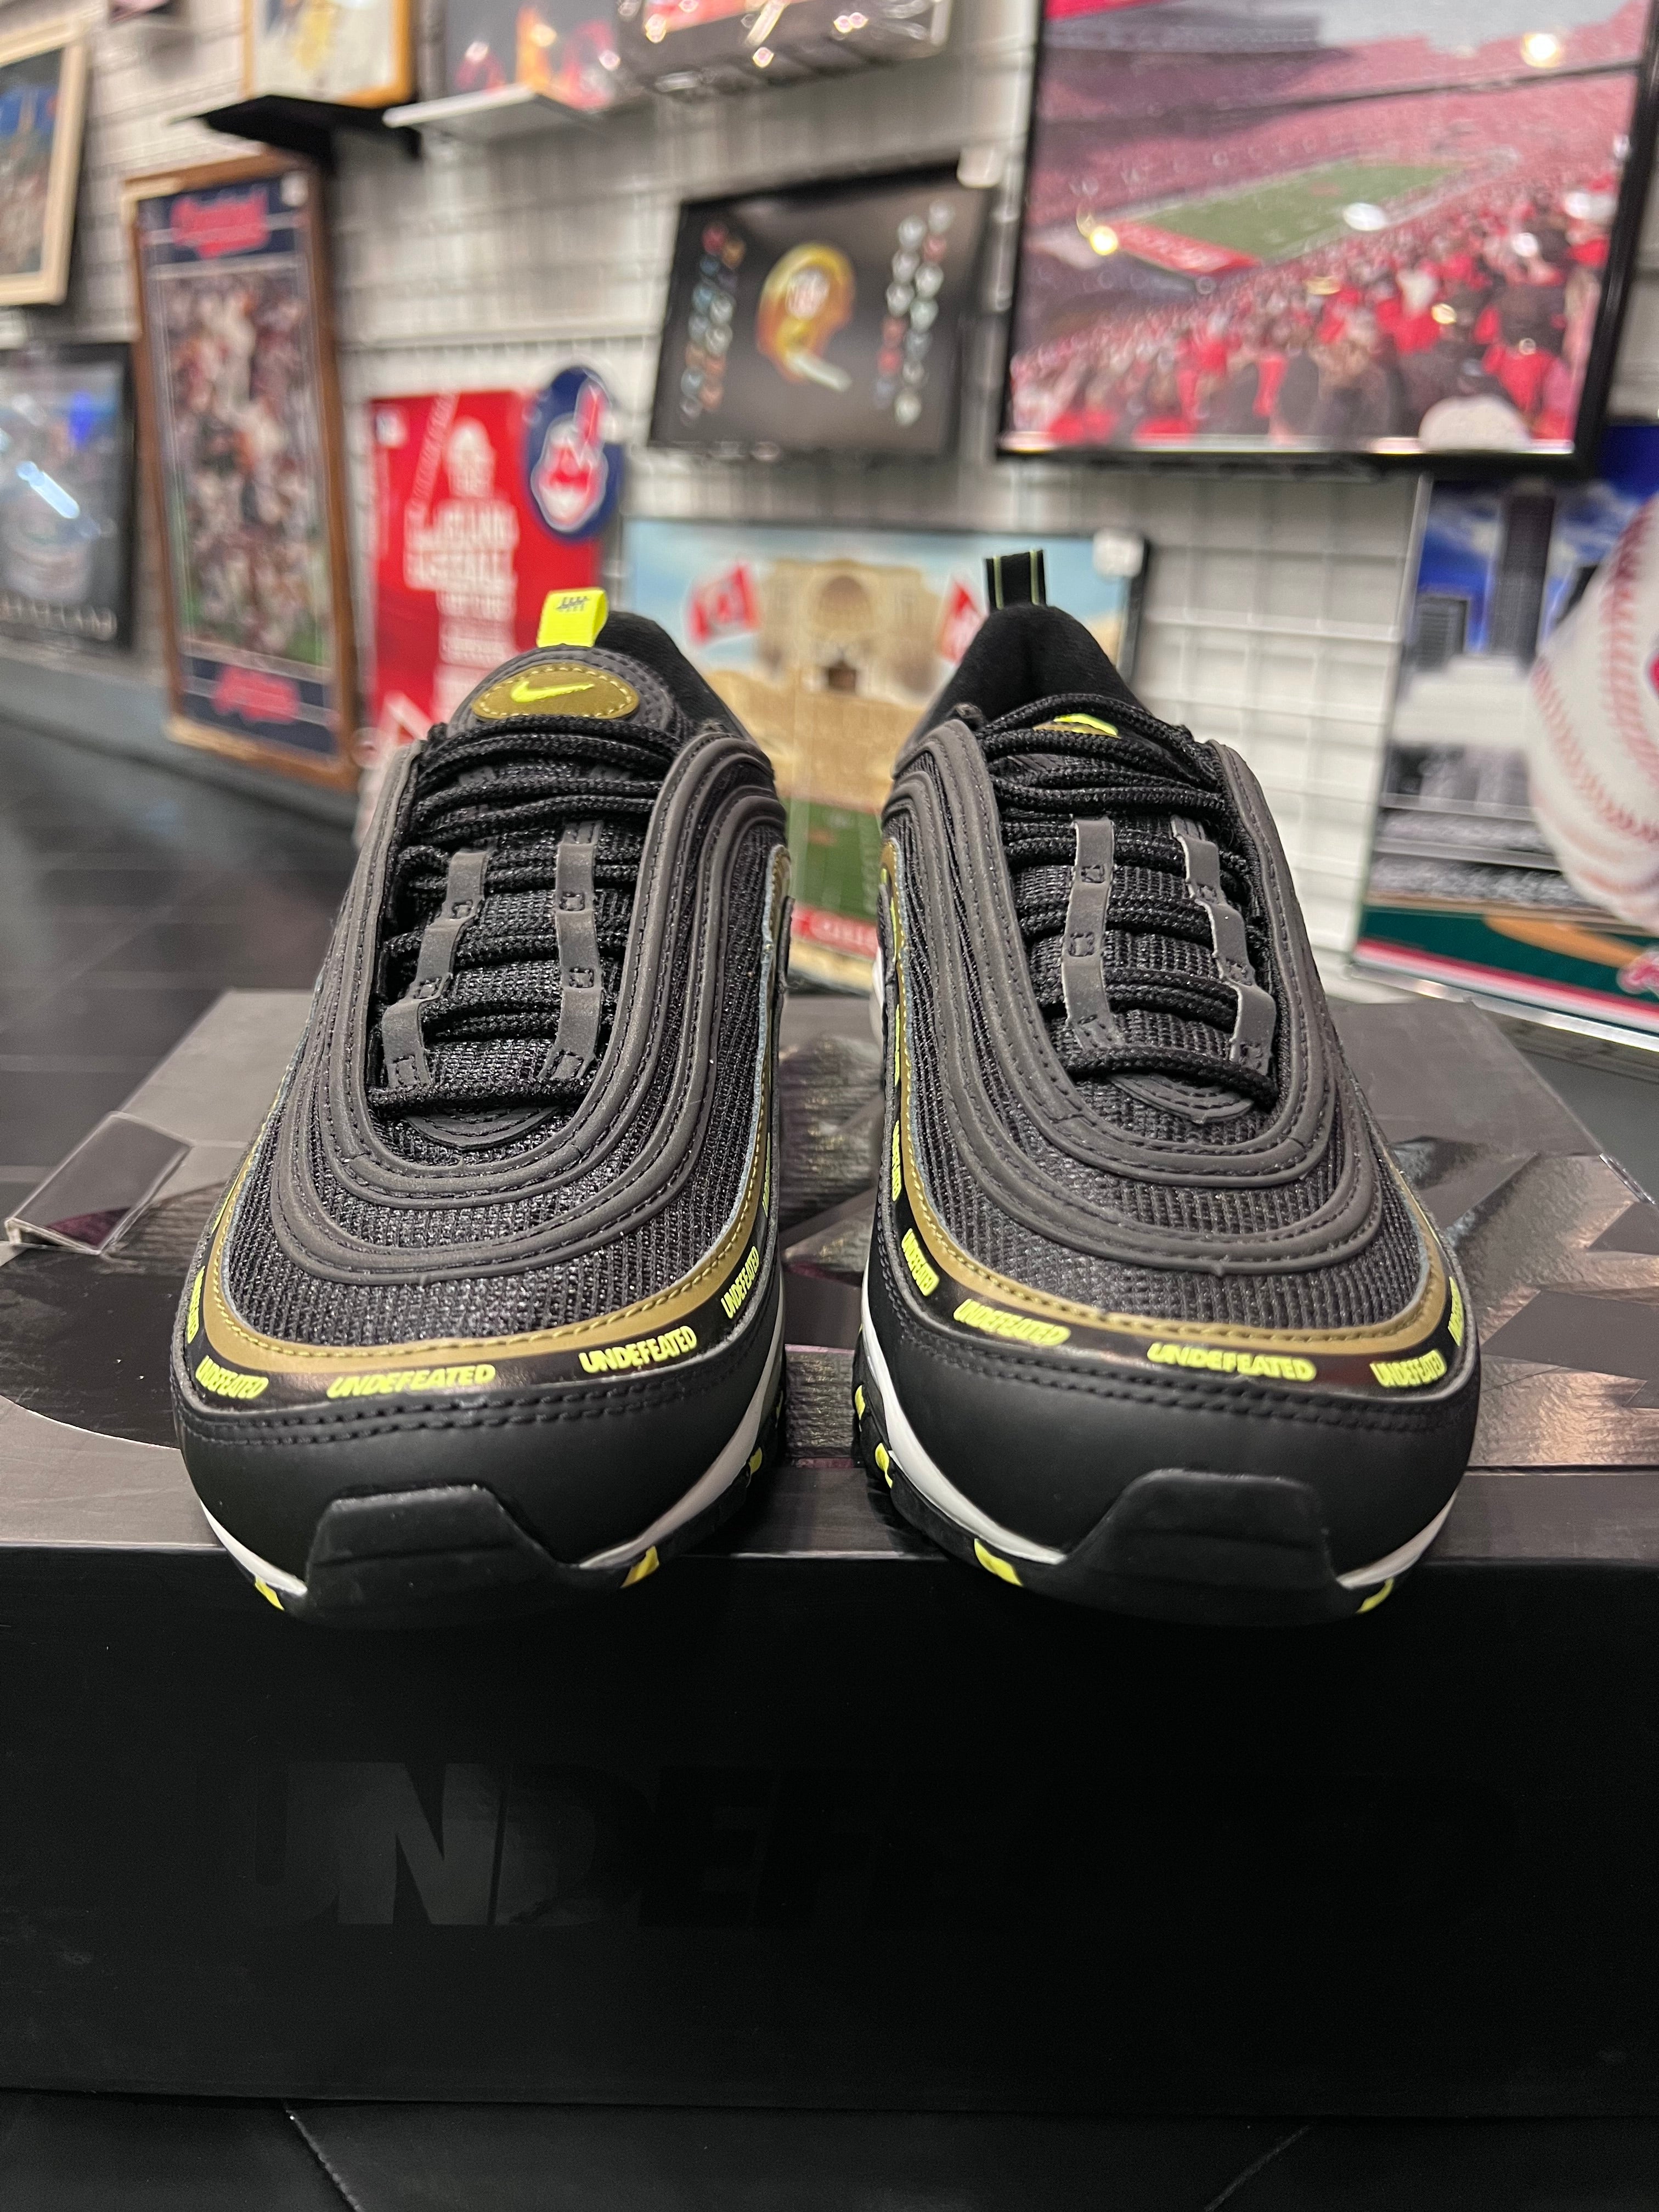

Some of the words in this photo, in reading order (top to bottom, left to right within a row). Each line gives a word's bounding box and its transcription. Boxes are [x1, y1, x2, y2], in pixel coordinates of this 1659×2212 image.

[720, 1246, 759, 1319] UNDEFEATED
[953, 1299, 1071, 1346] UNDEFEATED
[579, 1325, 697, 1373] UNDEFEATED
[1147, 1342, 1316, 1381] UNDEFEATED
[1369, 1350, 1447, 1387] UNDEFEATED
[195, 1355, 269, 1398] UNDEFEATED
[327, 1364, 495, 1398] UNDEFEATED
